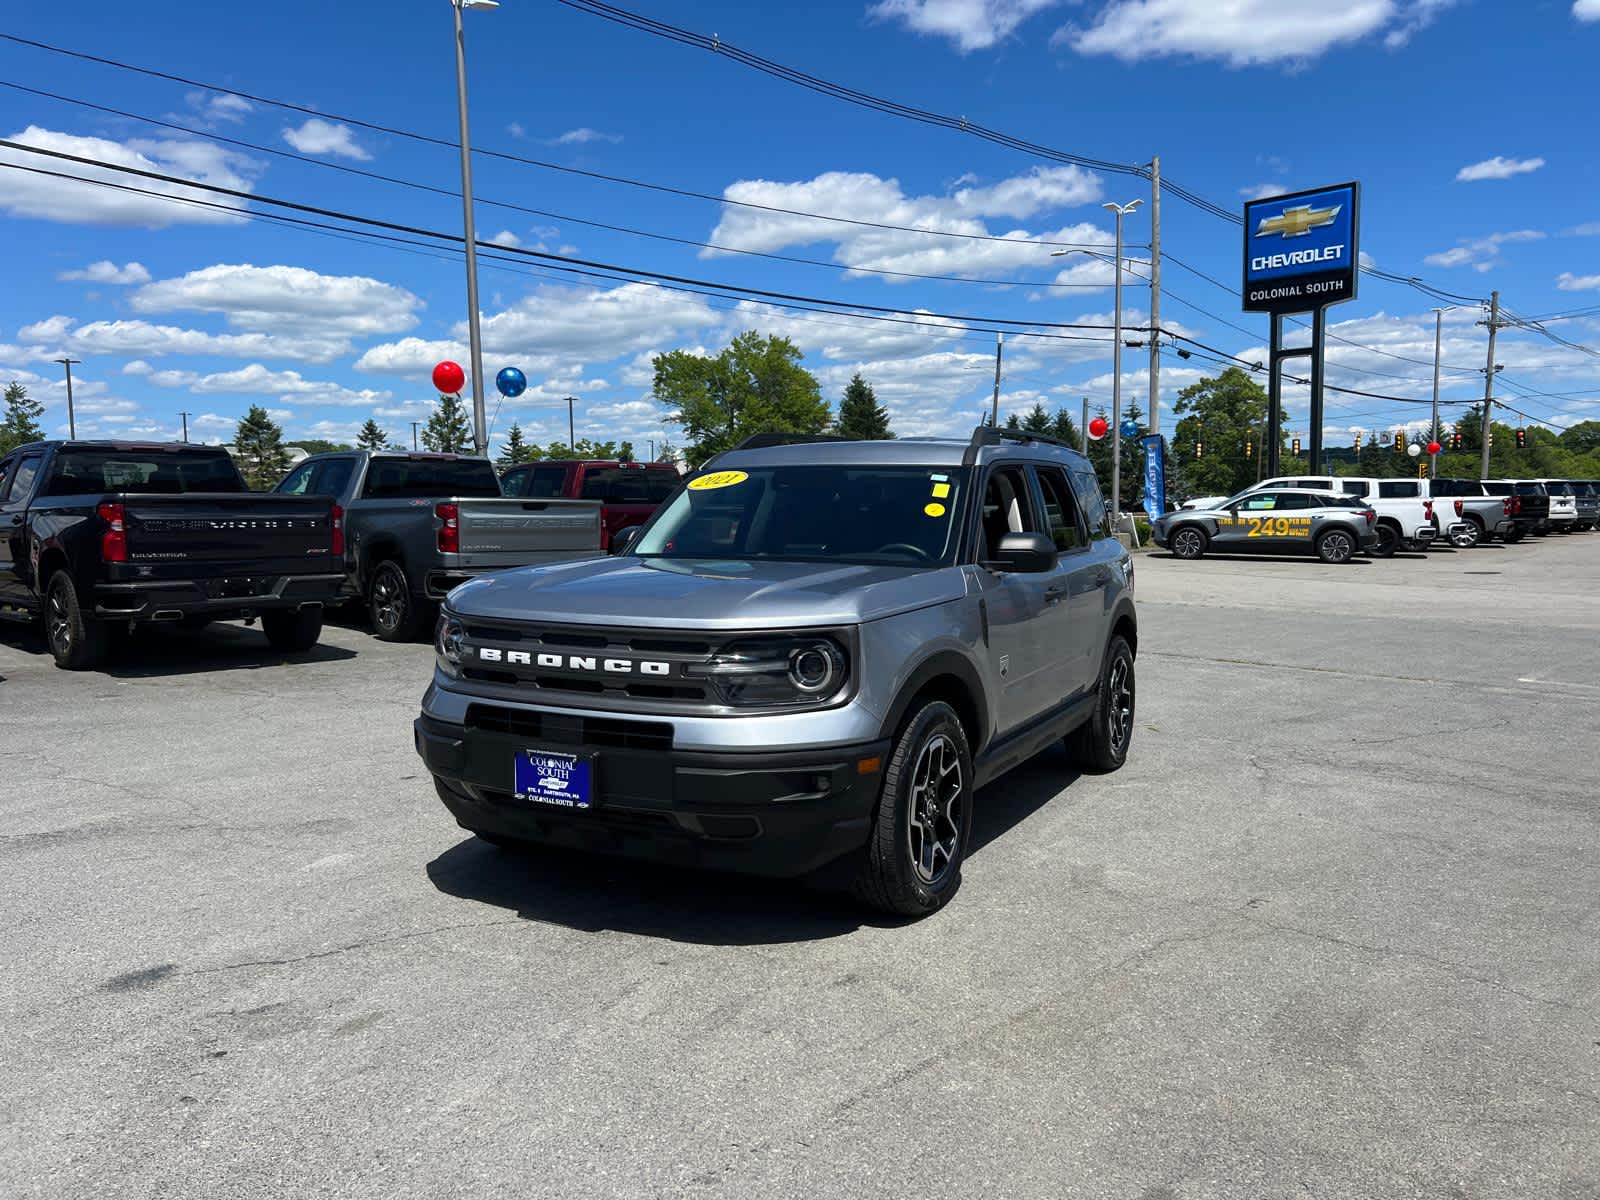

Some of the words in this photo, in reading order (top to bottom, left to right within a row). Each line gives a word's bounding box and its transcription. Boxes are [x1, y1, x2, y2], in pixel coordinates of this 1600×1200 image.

[1251, 244, 1345, 272] CHEVROLET
[1250, 286, 1302, 302] COLONIAL
[1306, 280, 1343, 294] SOUTH
[1247, 518, 1289, 537] 249
[479, 648, 670, 676] BRONCO
[530, 756, 577, 771] COLONIAL
[537, 766, 569, 779] SOUTH
[528, 794, 554, 805] COLONIAL
[555, 799, 574, 807] SOUTH
